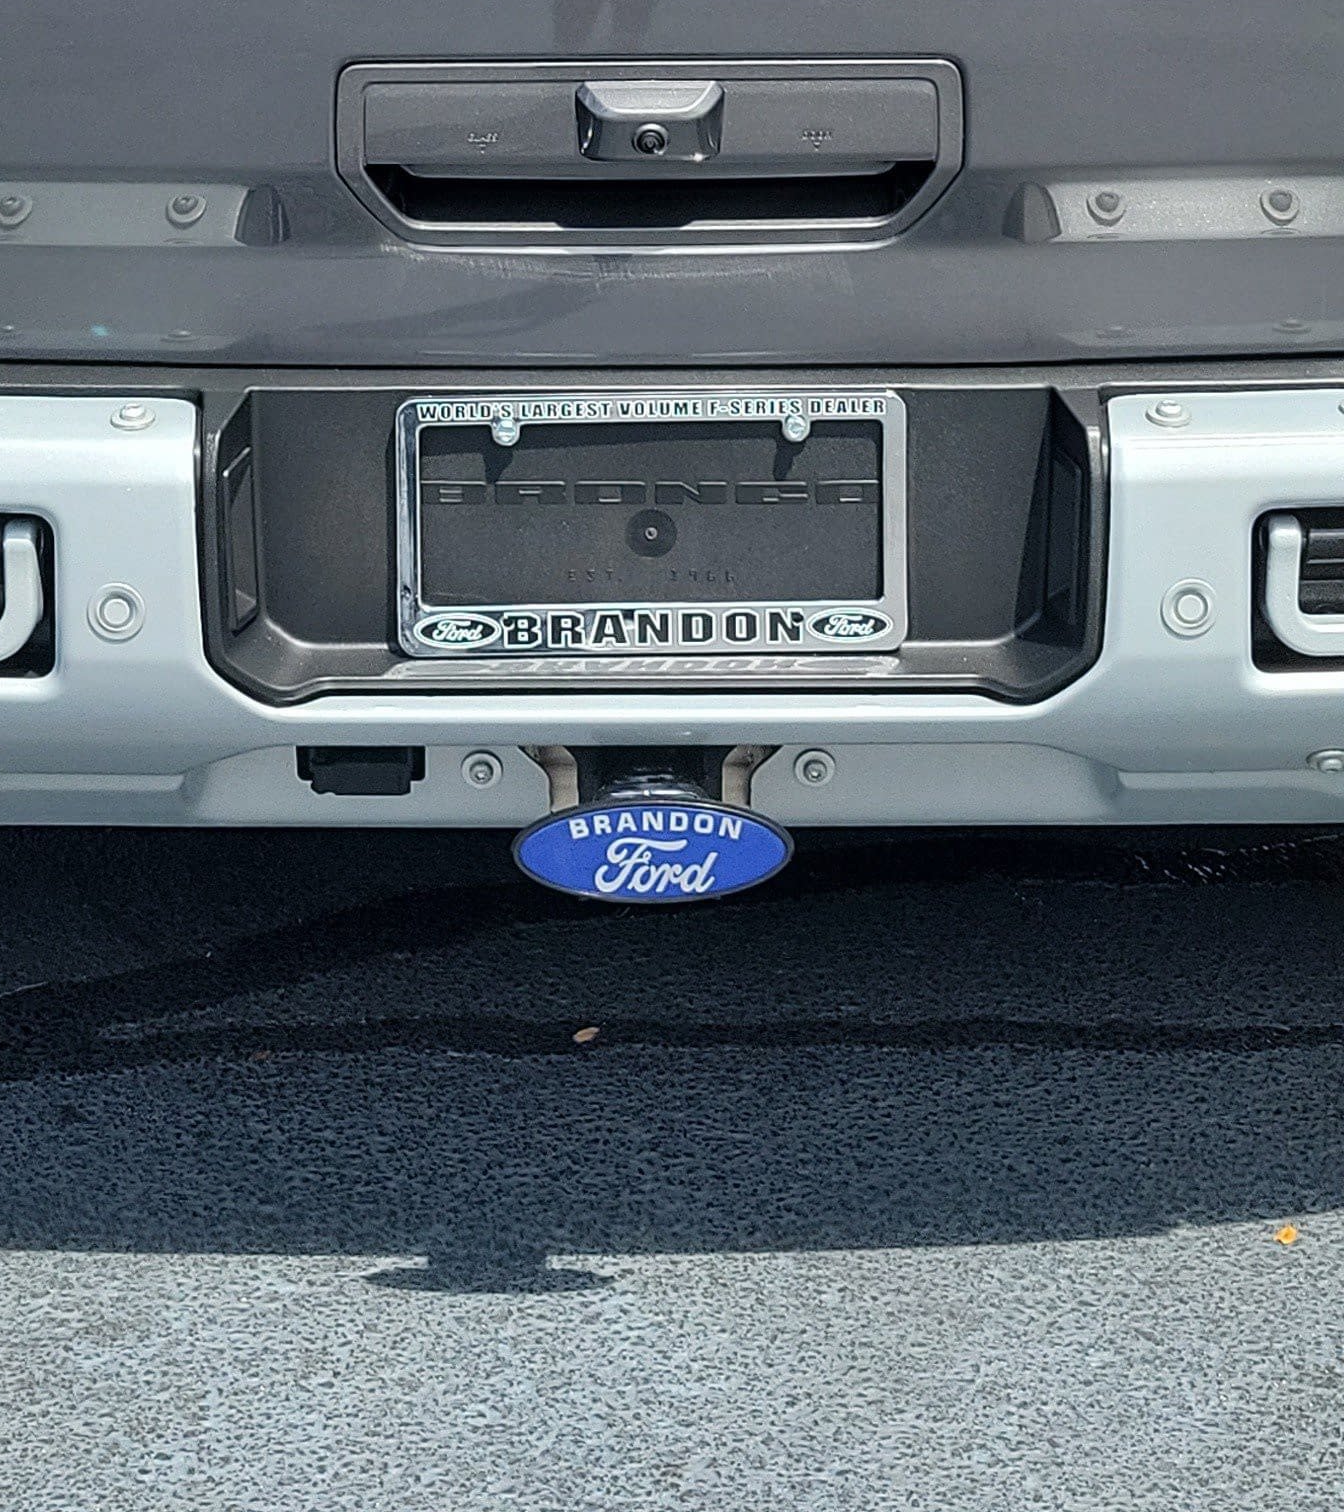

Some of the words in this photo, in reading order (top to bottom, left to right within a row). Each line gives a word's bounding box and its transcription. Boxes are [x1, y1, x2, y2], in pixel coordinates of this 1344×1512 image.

[416, 401, 514, 421] WORLD'S
[520, 400, 613, 420] LARGEST
[618, 398, 702, 418] VOLUME
[708, 397, 804, 417] F-SERIES
[809, 397, 887, 416] DEALER
[420, 480, 879, 505] BRONCO
[567, 568, 624, 583] EST.
[669, 567, 737, 583] 1966
[432, 619, 484, 643] Ford
[502, 607, 805, 649] BRANDON
[823, 614, 875, 637] Ford
[568, 810, 743, 840] BRANDON
[594, 837, 719, 893] Ford
